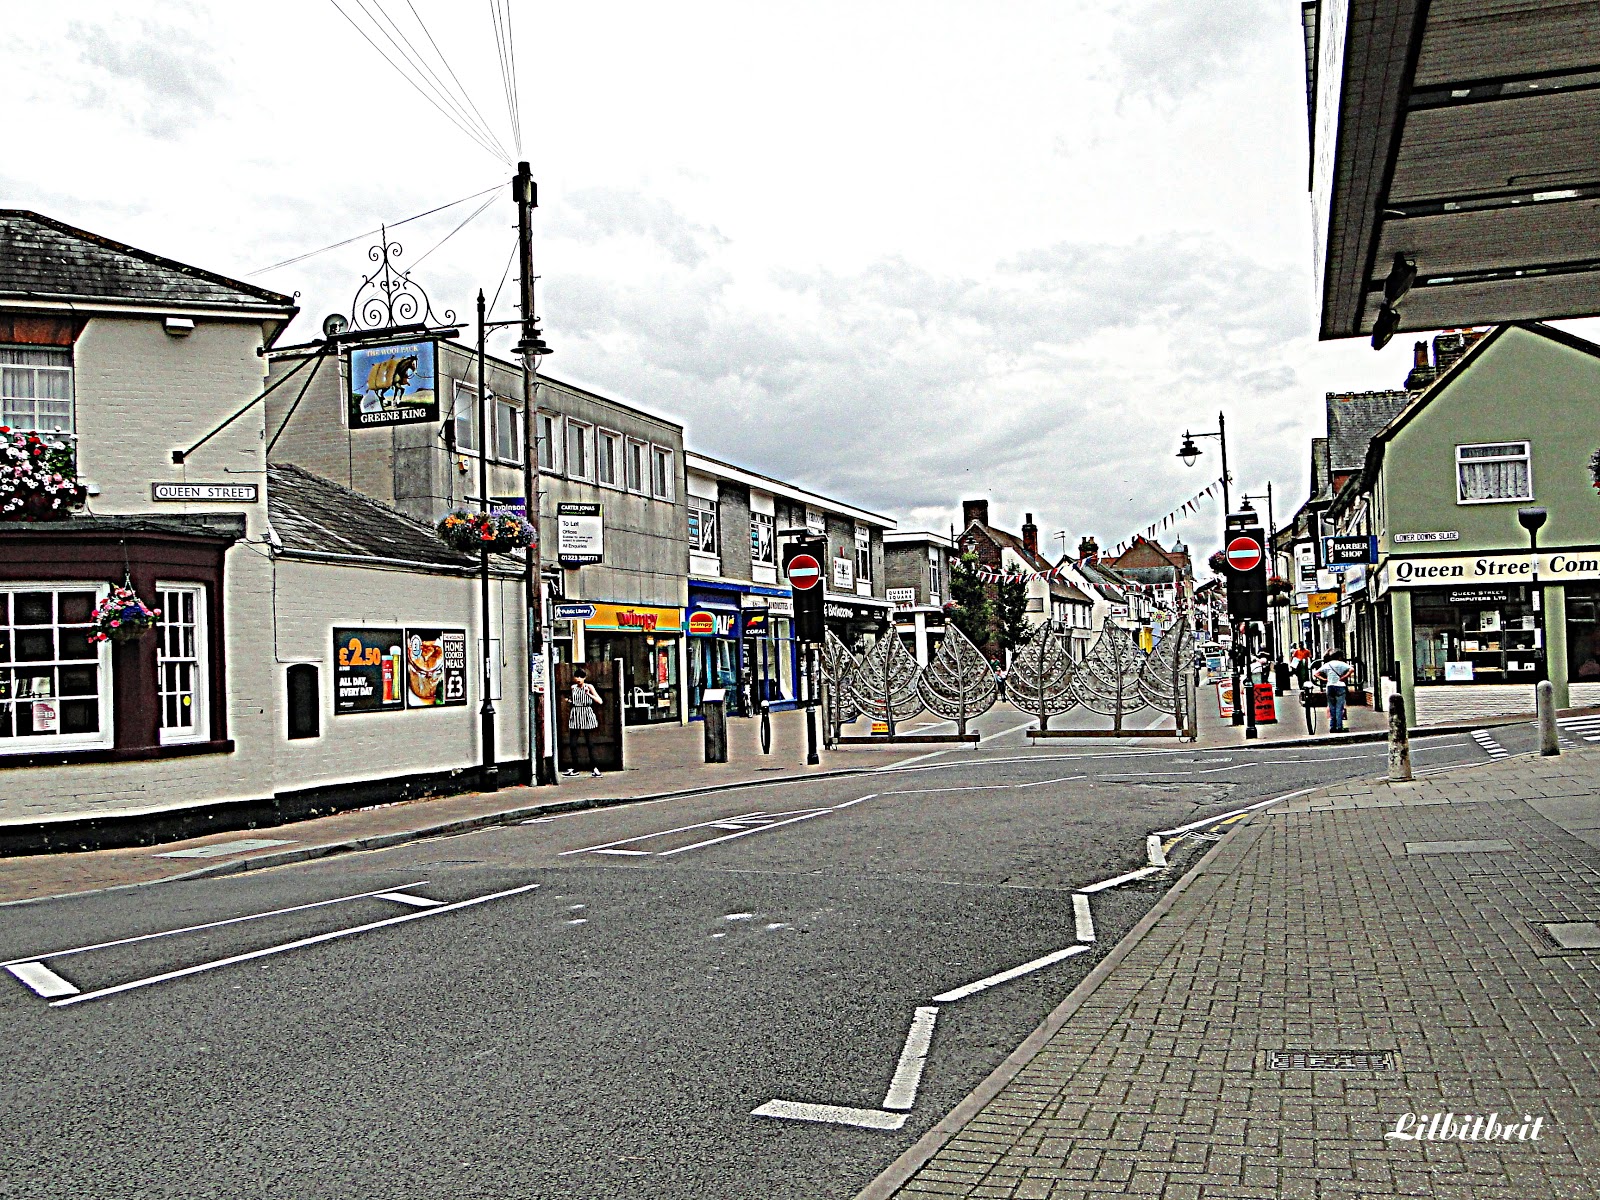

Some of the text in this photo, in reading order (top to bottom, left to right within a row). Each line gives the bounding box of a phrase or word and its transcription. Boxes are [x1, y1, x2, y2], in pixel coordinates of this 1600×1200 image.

[360, 408, 426, 423] GREENE KING
[160, 487, 252, 498] QUEEN STREET
[1395, 531, 1457, 541] LOWER DOWNS SLADE
[1334, 543, 1368, 551] BARBER
[1396, 556, 1600, 582] Queen Stree Com
[339, 637, 382, 666] £2.50
[444, 641, 464, 652] HOME
[444, 651, 464, 659] COOKED
[445, 659, 464, 669] MEALS
[339, 677, 352, 687] ALL
[447, 675, 464, 698] £3
[339, 686, 374, 697] EVERY DAY
